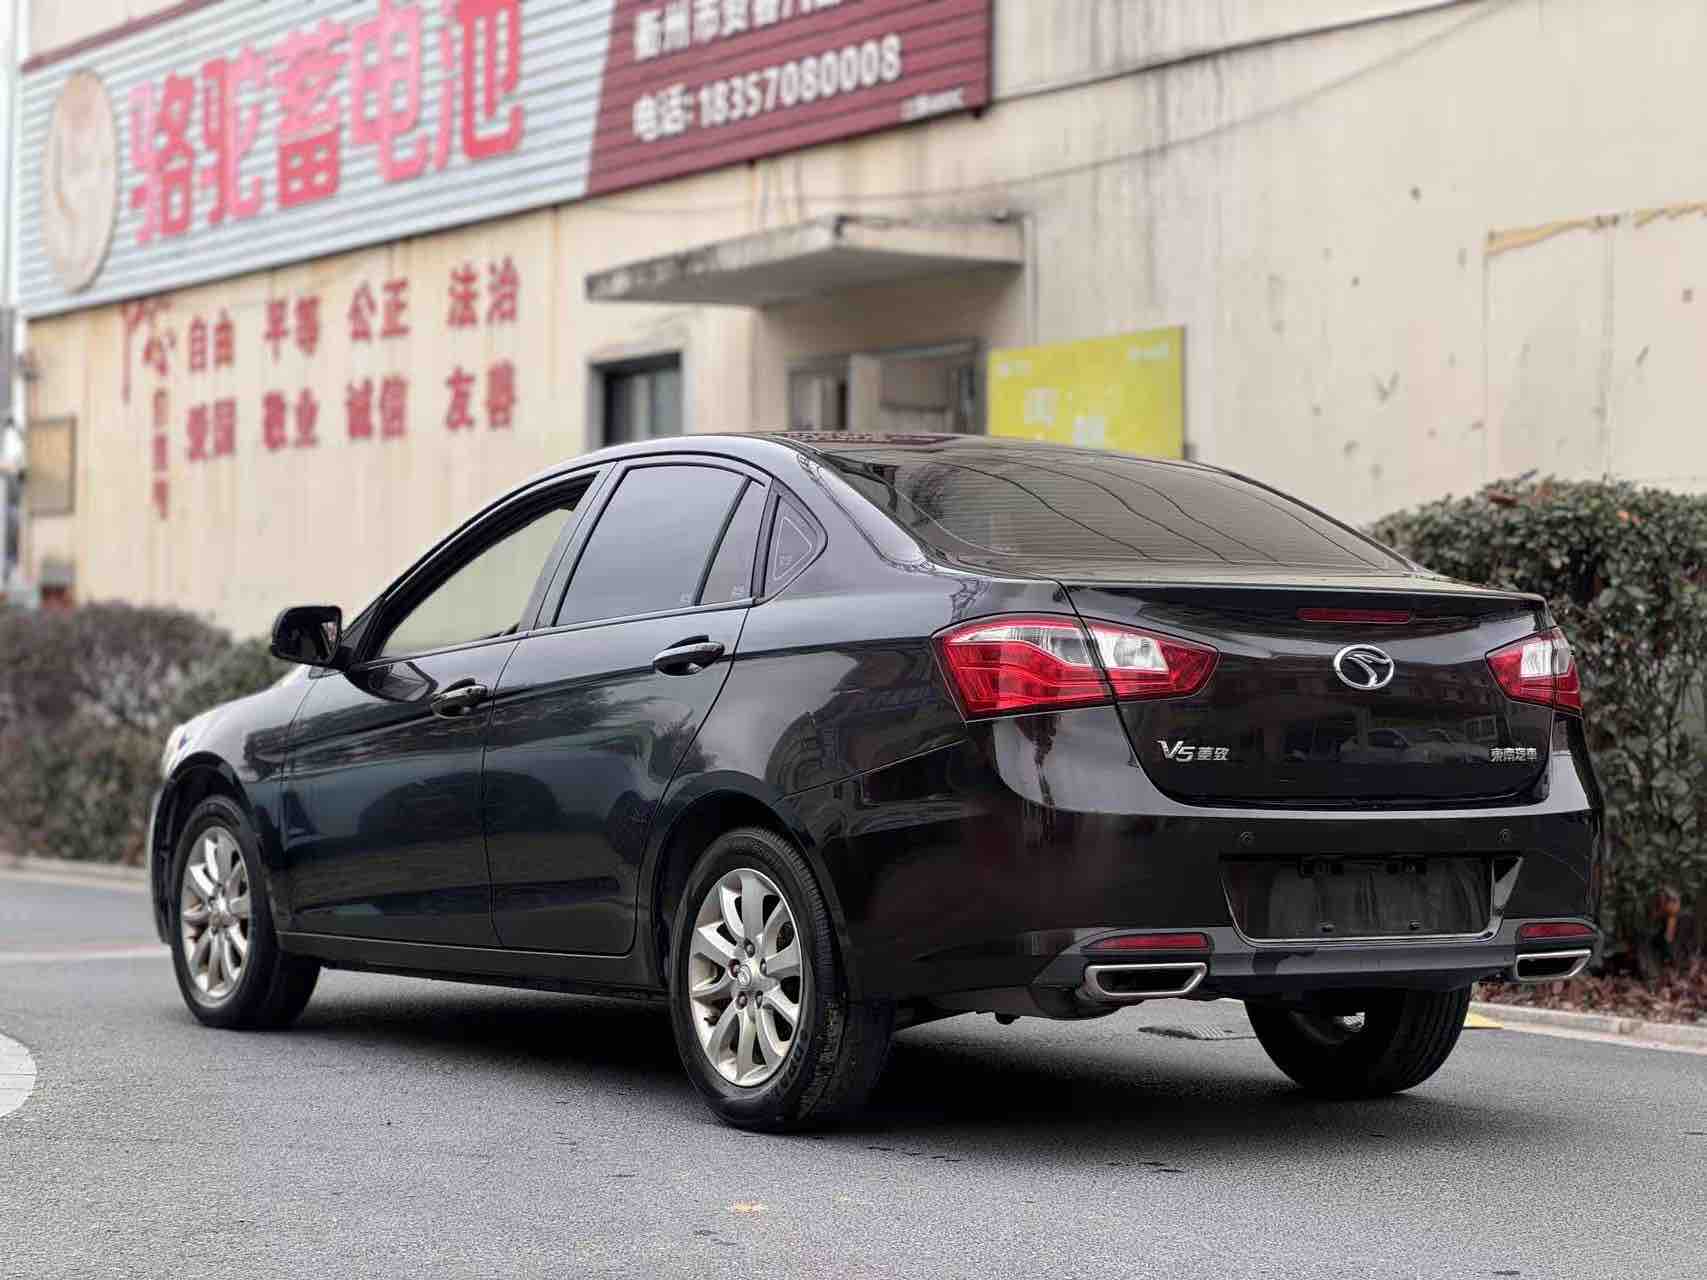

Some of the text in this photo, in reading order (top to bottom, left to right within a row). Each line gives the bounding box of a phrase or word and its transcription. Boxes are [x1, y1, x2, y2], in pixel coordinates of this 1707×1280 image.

[128, 0, 524, 246] 骆驼蓄电池
[188, 256, 520, 374] 自由 平等 公正 法治
